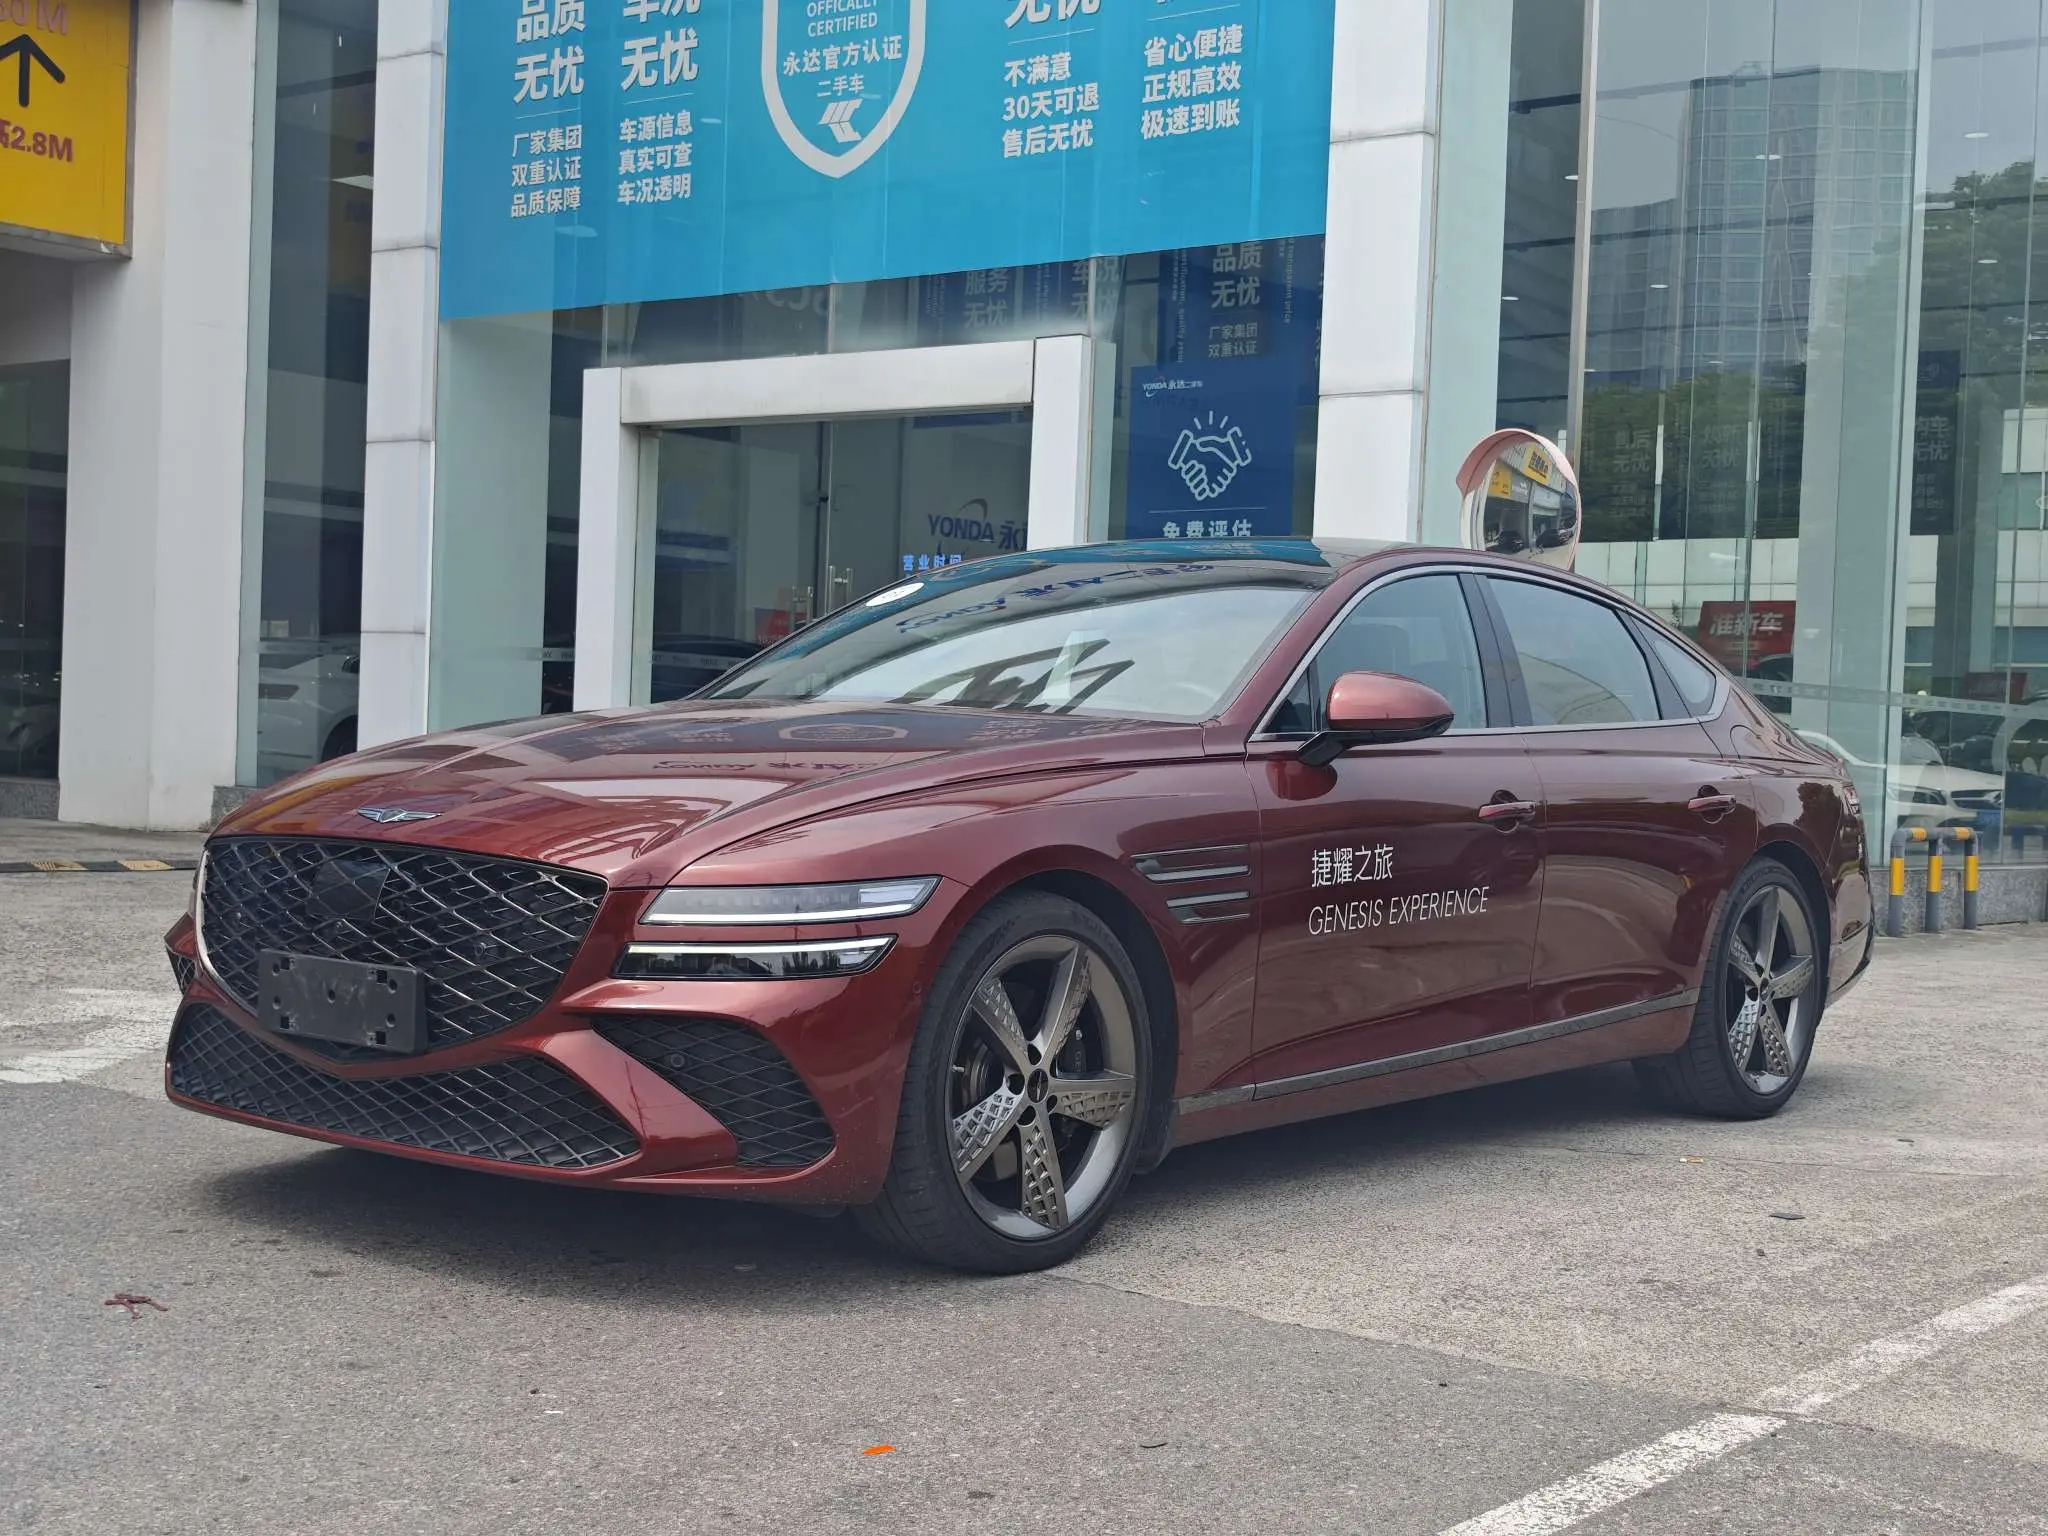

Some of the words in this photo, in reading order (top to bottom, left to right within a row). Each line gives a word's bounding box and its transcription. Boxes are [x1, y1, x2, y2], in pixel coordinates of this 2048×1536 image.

[0, 0, 29, 26] 0
[516, 0, 586, 44] 品质
[807, 12, 878, 37] CERTIFIED
[620, 27, 699, 91] 无忧
[783, 34, 902, 77] 永达官方认证
[1143, 23, 1243, 68] 省心便捷
[513, 45, 585, 104] 无忧
[816, 73, 865, 97] 二手车
[1004, 51, 1072, 88] 不满意
[1142, 60, 1242, 103] 正规高效
[1002, 82, 1100, 121] 30天可退
[1140, 98, 1240, 140] 极速到账
[512, 124, 583, 157] 厂家集团
[619, 109, 693, 143] 车源信息
[1002, 118, 1094, 158] 售后无忧
[511, 156, 582, 187] 双重认证
[618, 142, 693, 176] 真实可查
[510, 186, 582, 218] 品质保障
[617, 173, 692, 205] 车况透明
[1212, 242, 1262, 273] 品质
[1210, 276, 1261, 309] 无忧
[927, 513, 994, 544] YONDA
[998, 519, 1027, 551] 永
[1162, 518, 1252, 538] 免费评估
[1311, 843, 1394, 888] 捷耀之旅
[1308, 899, 1384, 935] GENESIS
[1388, 886, 1490, 925] EXPERIENCE
